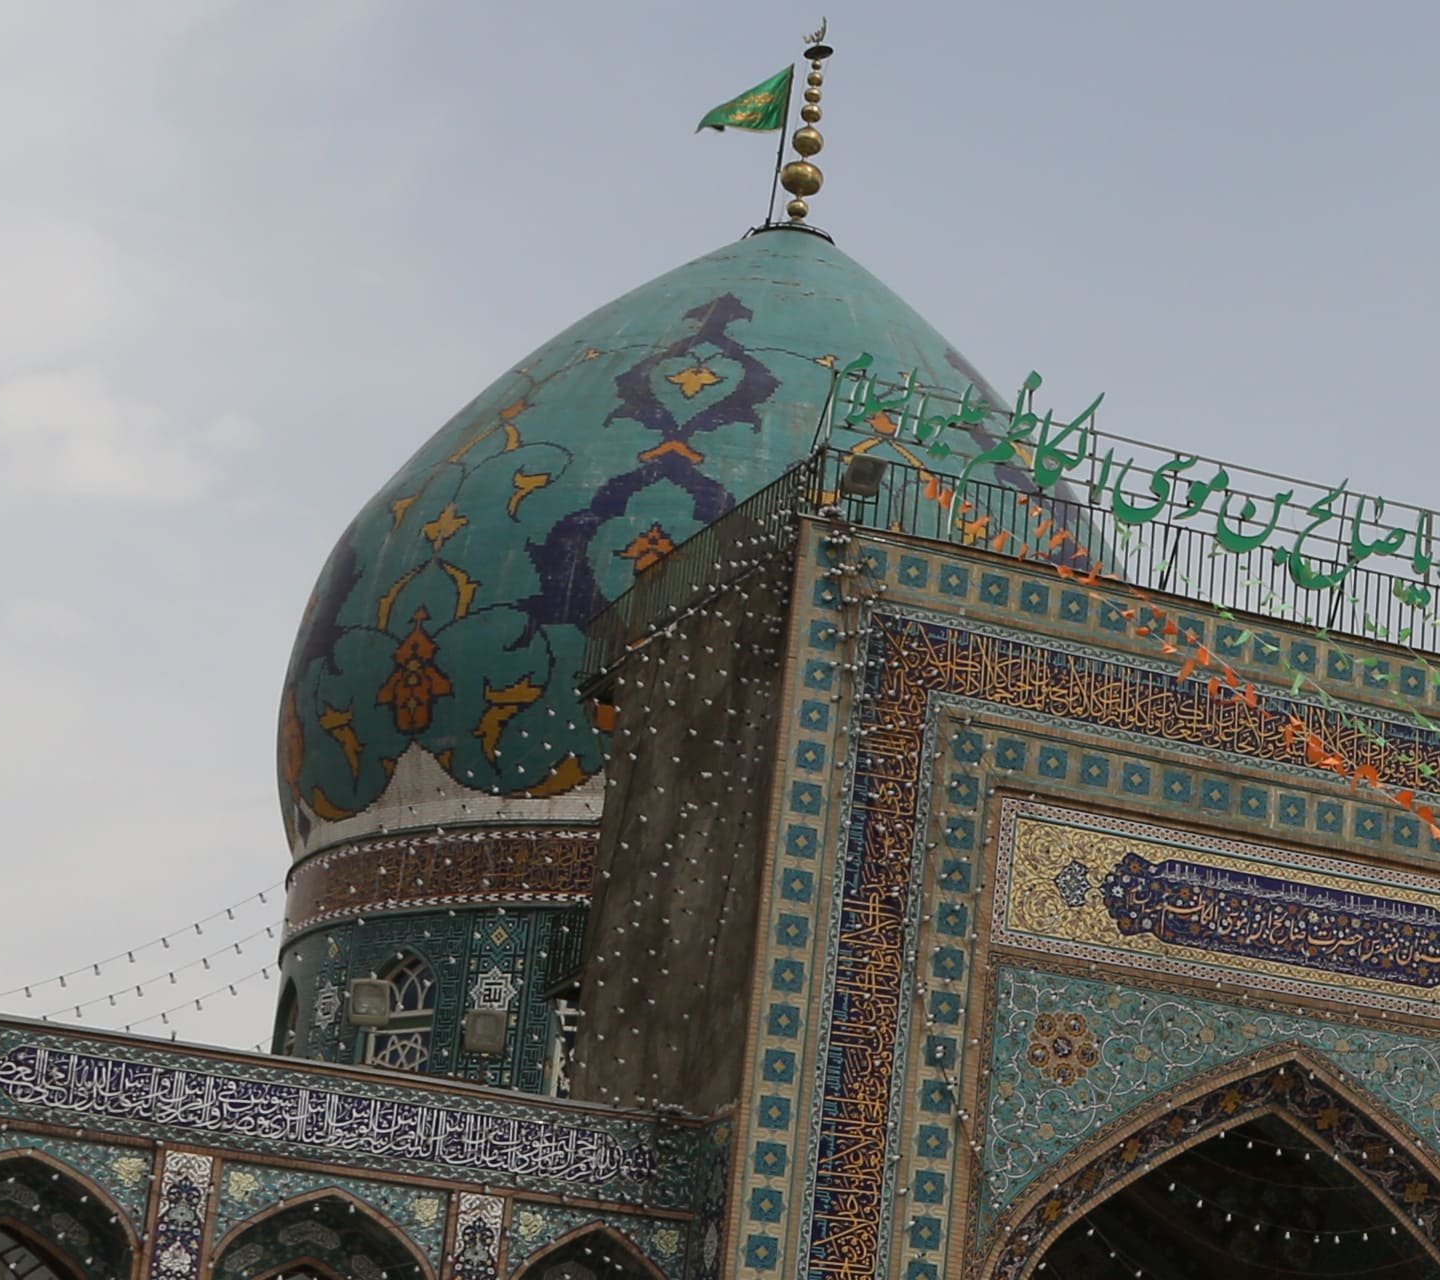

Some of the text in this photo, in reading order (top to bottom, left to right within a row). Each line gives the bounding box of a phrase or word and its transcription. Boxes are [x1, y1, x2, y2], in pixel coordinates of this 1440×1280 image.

[825, 352, 918, 440] السلام
[947, 370, 1114, 538] الکاظم
[1112, 455, 1229, 524] موسی
[1217, 489, 1294, 566] بن
[1289, 478, 1406, 590] صالح
[1405, 510, 1433, 609] یا
